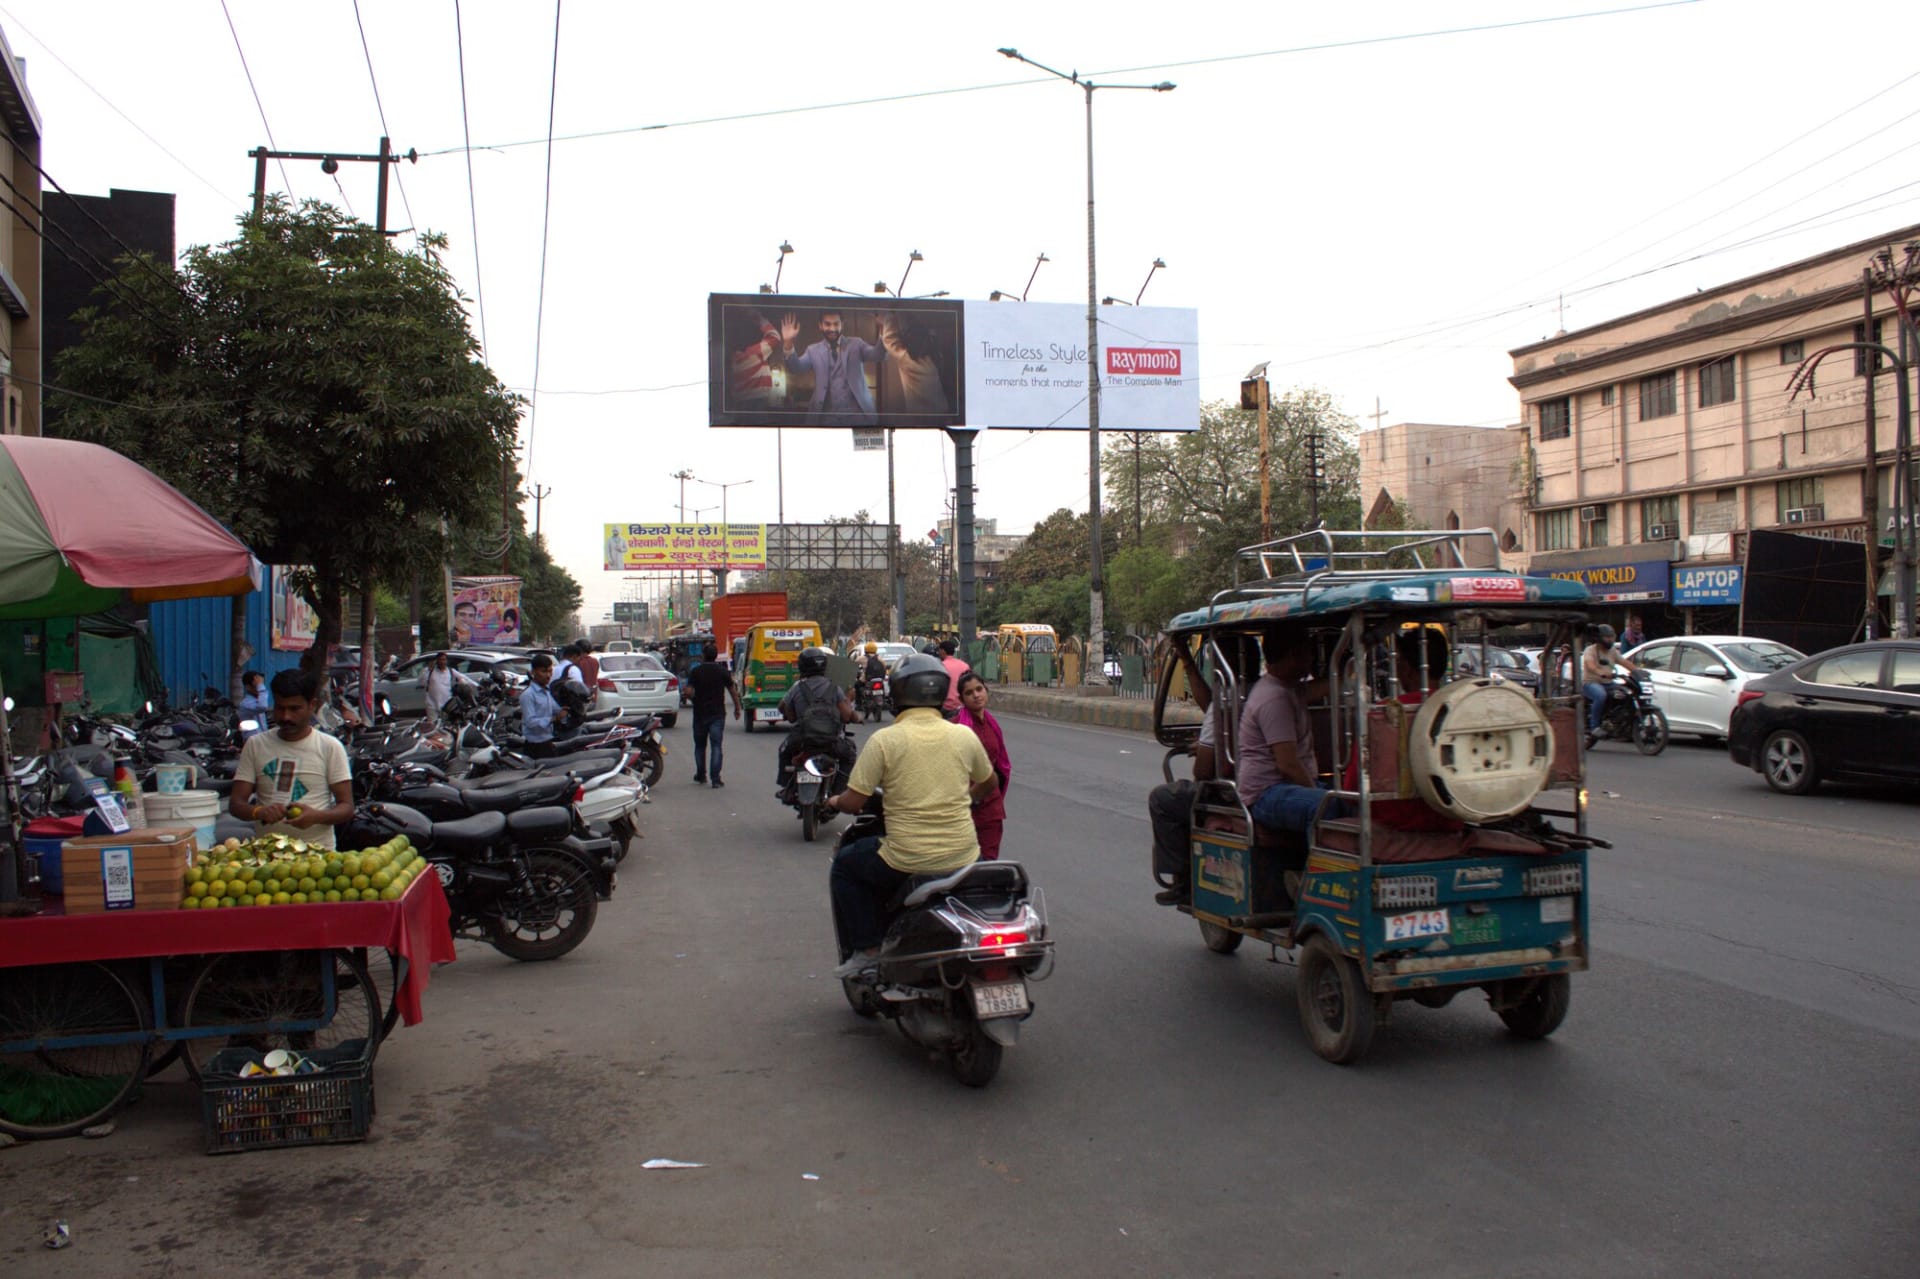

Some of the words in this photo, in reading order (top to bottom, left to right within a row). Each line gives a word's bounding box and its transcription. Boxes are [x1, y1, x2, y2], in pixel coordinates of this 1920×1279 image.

[981, 341, 1043, 360] Timeless
[1049, 343, 1087, 364] Style
[1021, 364, 1034, 376] for
[1035, 364, 1048, 373] the
[985, 378, 1028, 387] moments
[1031, 376, 1050, 388] that
[1053, 378, 1084, 388] matter
[1107, 376, 1122, 385] The
[1125, 377, 1162, 387] Complete
[1164, 377, 1182, 387] Man
[629, 524, 671, 535] किराये
[676, 527, 694, 535] पर
[1587, 566, 1636, 585] WORLD
[1675, 569, 1739, 589] LAPTOP
[1392, 912, 1444, 938] 2743
